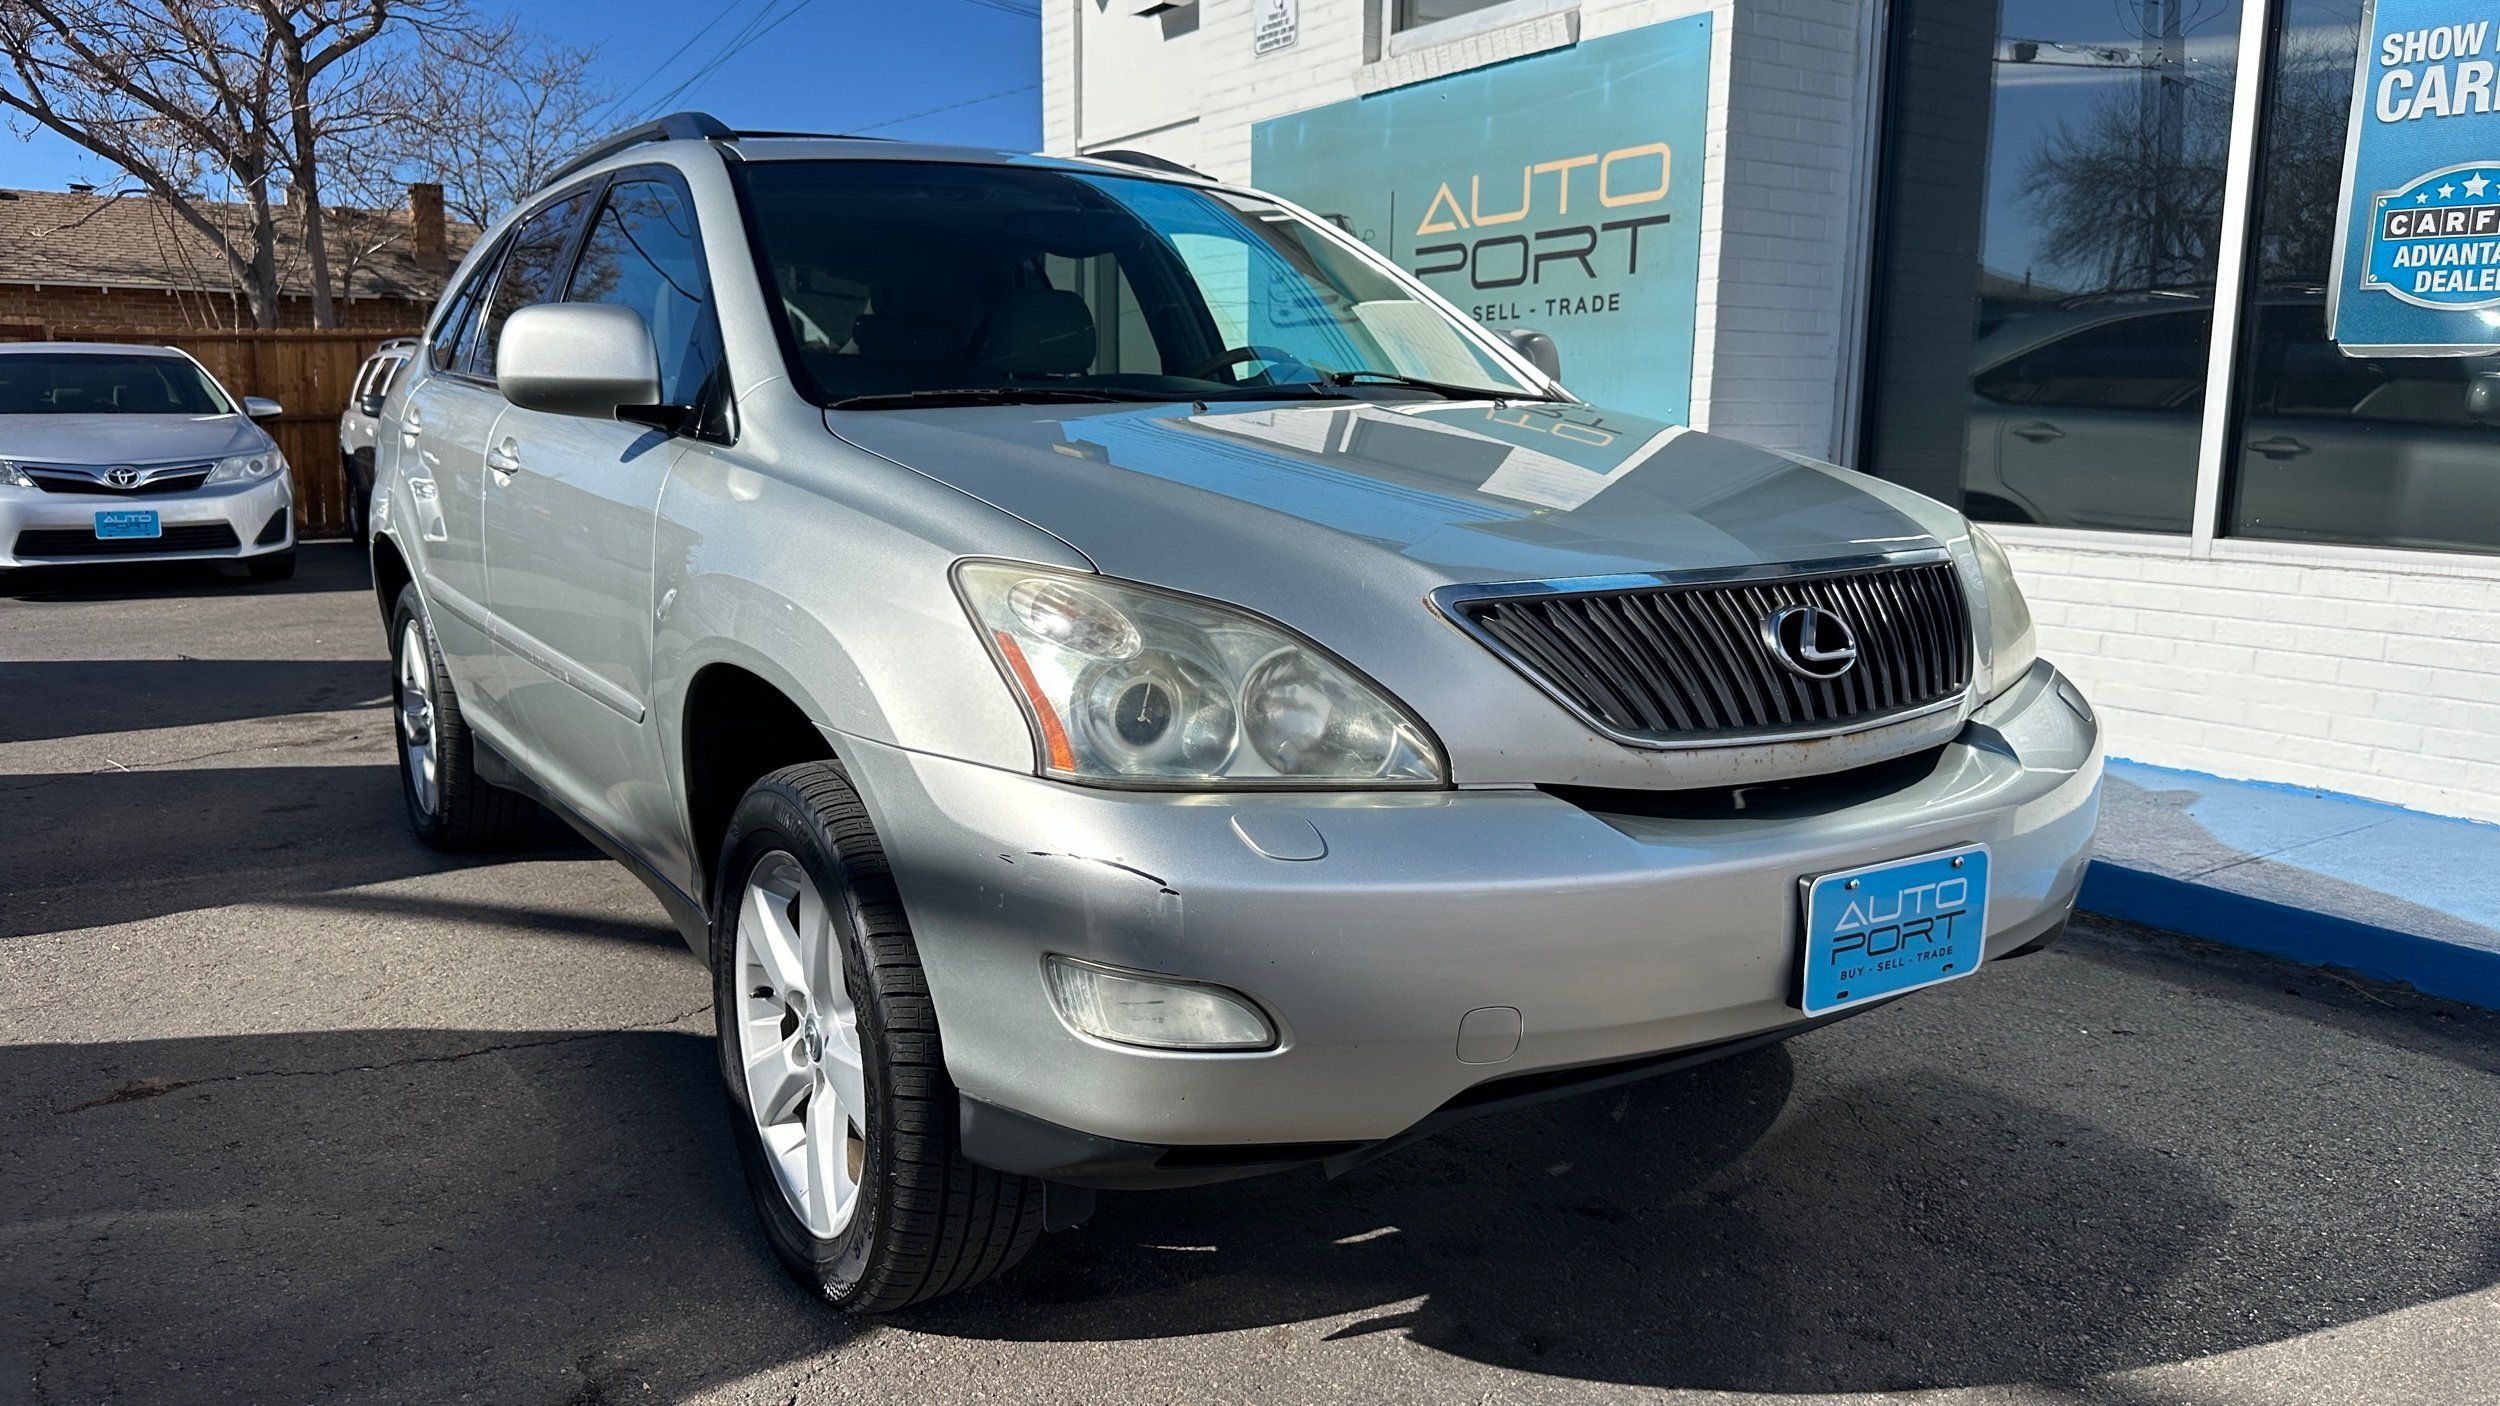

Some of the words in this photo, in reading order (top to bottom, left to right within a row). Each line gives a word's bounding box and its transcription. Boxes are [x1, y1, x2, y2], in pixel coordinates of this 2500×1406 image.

[2381, 21, 2489, 66] SHOW
[2376, 60, 2500, 122] CAR
[1416, 142, 1671, 235] AUTO
[2390, 210, 2500, 235] CARF
[1415, 214, 1671, 290] PORT
[1472, 303, 1521, 322] SELL
[1545, 293, 1620, 317] TRADE
[103, 514, 152, 523] AUTO
[1834, 877, 1968, 932] AUTO
[1831, 909, 1967, 966] PORT
[1840, 966, 1865, 981] BUY
[1877, 957, 1905, 972] SELL
[1917, 945, 1953, 962] TRADE
